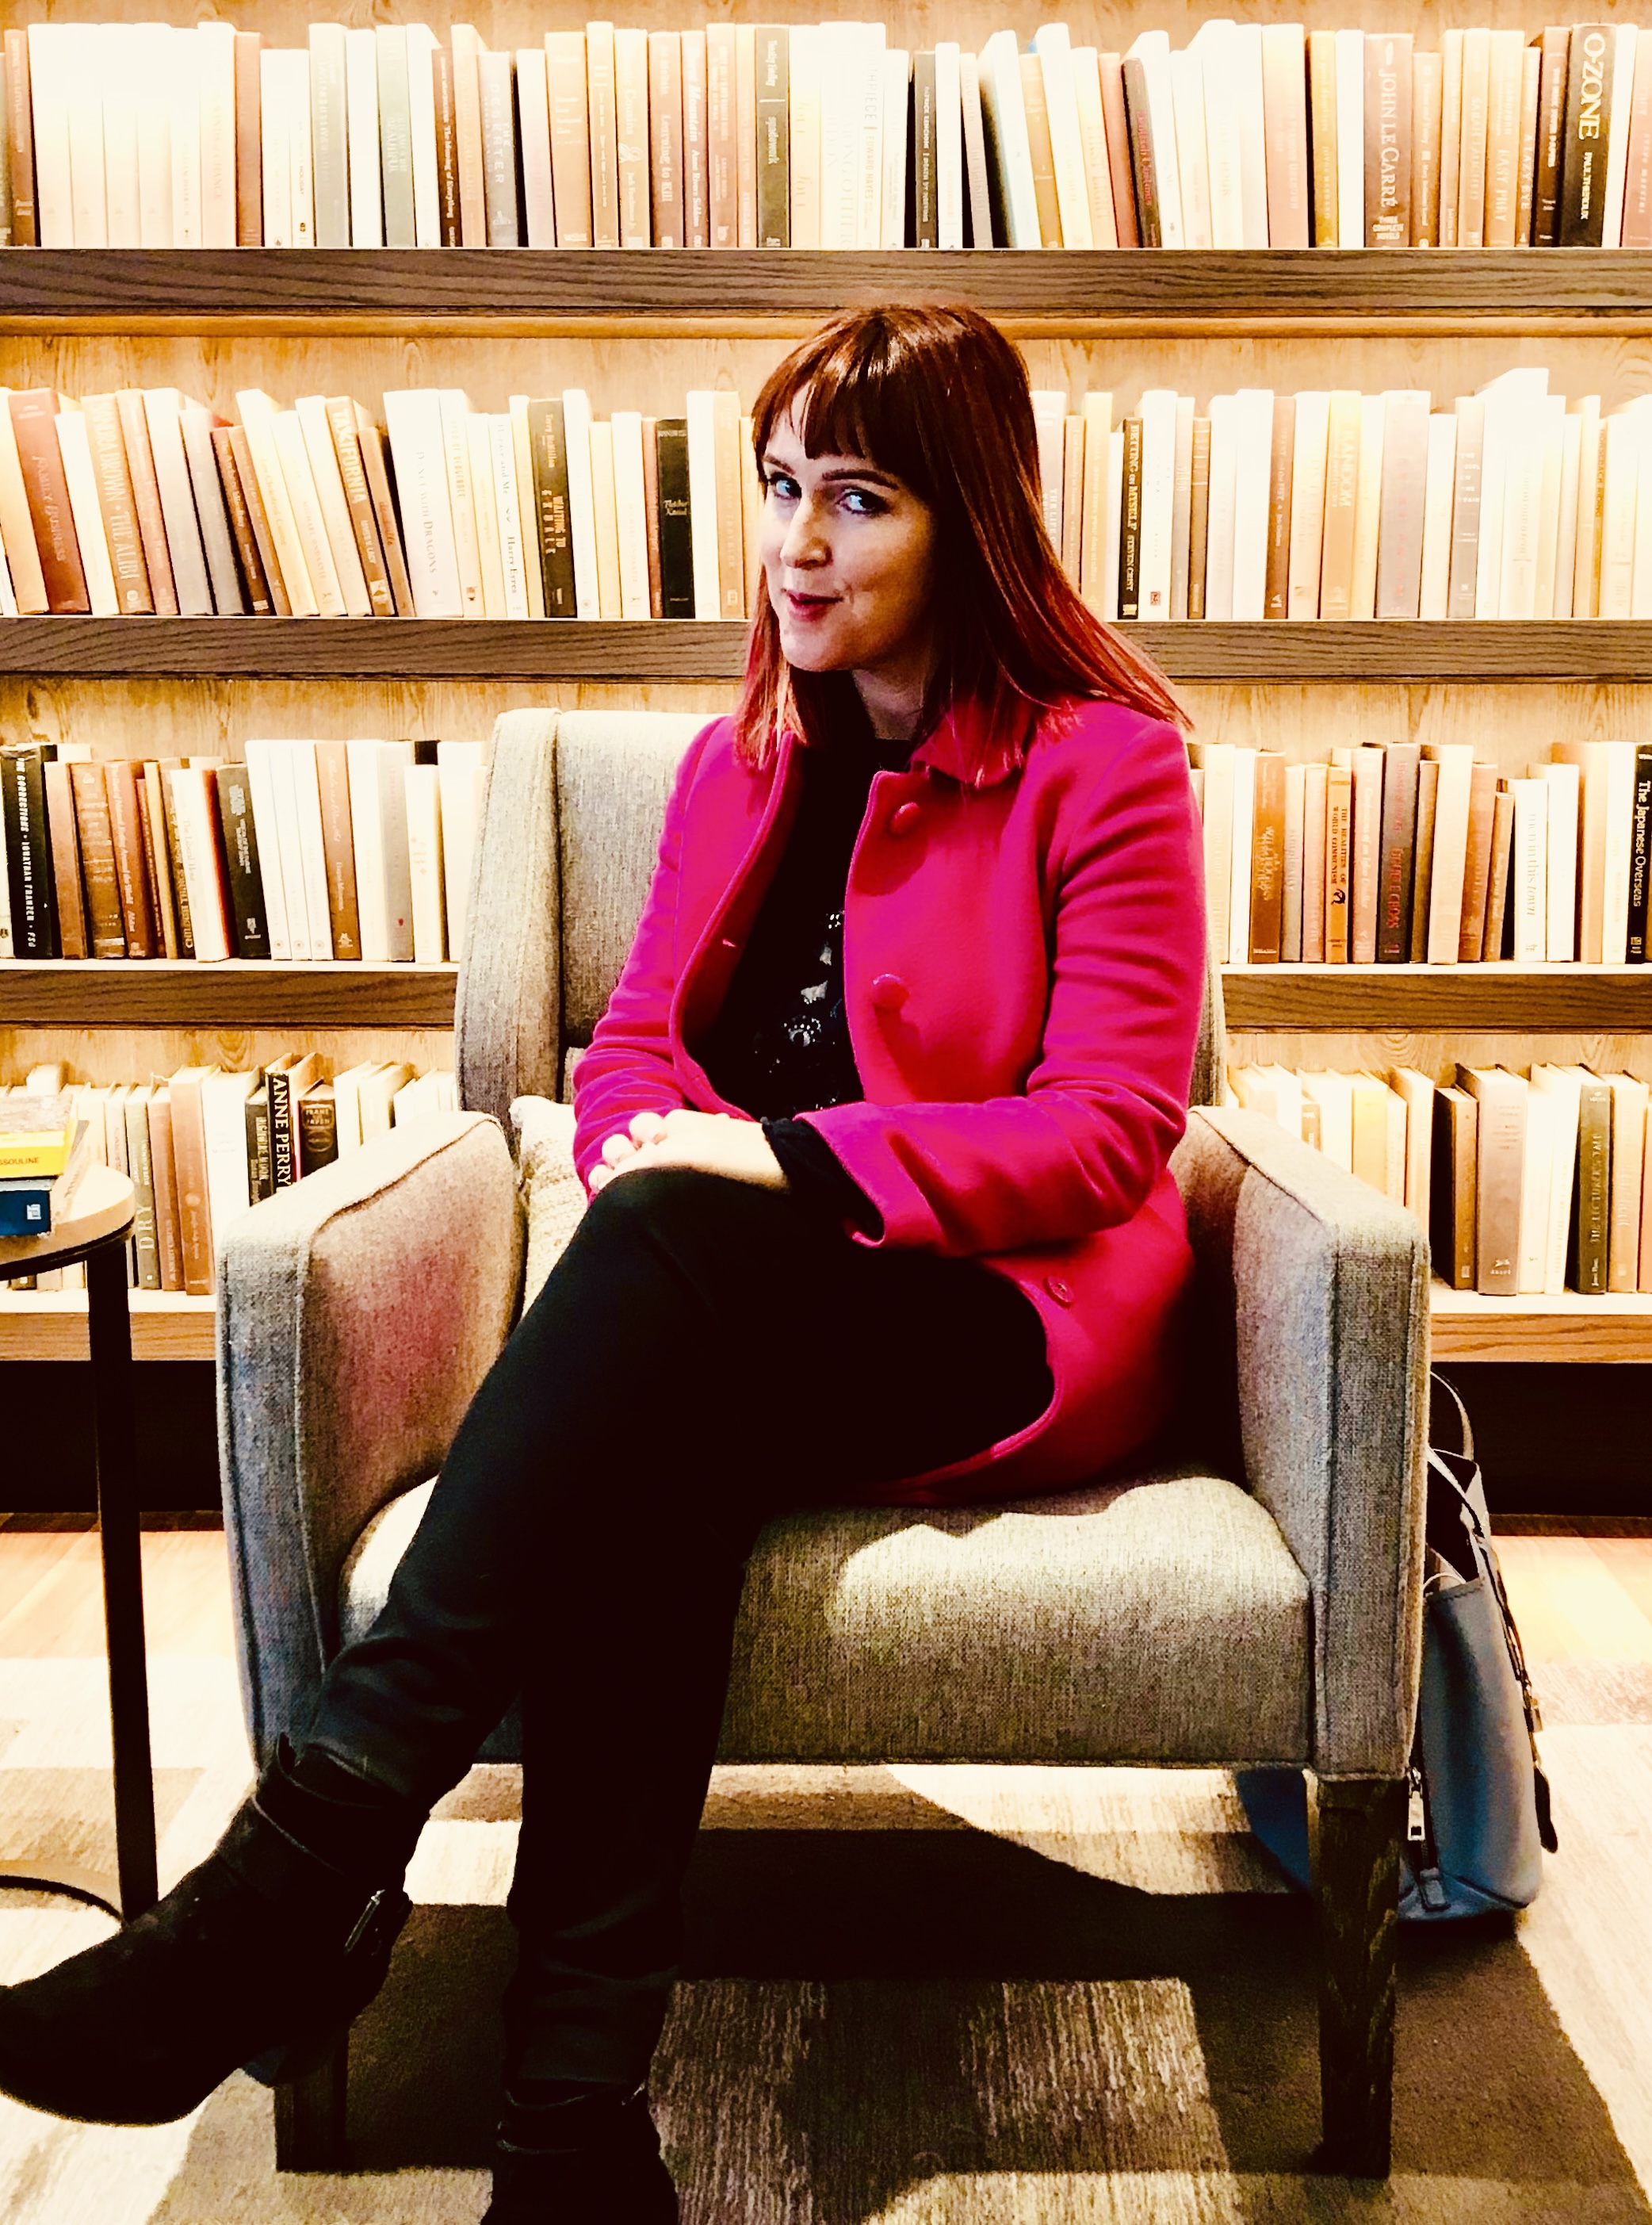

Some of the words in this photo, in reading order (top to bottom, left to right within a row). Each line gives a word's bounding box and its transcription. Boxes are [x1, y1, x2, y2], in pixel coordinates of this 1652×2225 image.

[1378, 68, 1398, 118] JOHN
[1578, 33, 1606, 141] O-ZONE
[212, 105, 221, 142] WINDS
[623, 89, 637, 135] Cousins
[687, 84, 702, 142] Mountain
[490, 82, 504, 183] DESERTER
[660, 114, 672, 164] Learning
[767, 116, 779, 164] spadework
[1087, 125, 1106, 170] FIRST
[1380, 123, 1397, 144] LE
[691, 149, 700, 170] Anne
[864, 136, 874, 170] EDWARD
[1521, 147, 1533, 182] LAZY
[1583, 152, 1593, 172] PAUL
[213, 154, 223, 201] CHANGE
[662, 167, 672, 178] to
[692, 172, 701, 196] Rivers
[864, 174, 874, 199] HAYES
[1221, 161, 1232, 197] FOUR
[1380, 147, 1400, 208] CARRÉ
[444, 181, 456, 218] Everything
[661, 182, 673, 202] Kill
[1091, 175, 1111, 221] LIGHT
[1580, 172, 1592, 220] THEROUX
[692, 197, 702, 227] Siddons
[91, 401, 118, 452] SANDRA
[544, 414, 554, 433] Terry
[546, 435, 556, 469] McMillan
[1128, 424, 1140, 473] BETTING
[1596, 428, 1606, 484] HORSEBACK
[98, 451, 123, 502] BROWN
[331, 408, 367, 504] TAXIFORNIA
[365, 547, 377, 564] LACY
[453, 456, 466, 498] VENGEANCE
[499, 461, 508, 478] and
[1338, 431, 1355, 507] RANDOM
[419, 492, 430, 517] WITH
[502, 481, 510, 495] Me
[1049, 488, 1057, 508] THE
[1594, 486, 1603, 518] RIDING
[33, 456, 53, 500] FAMILY
[44, 505, 66, 561] BUSINESS
[553, 496, 565, 534] WAITING
[1050, 511, 1058, 534] LIFE
[1090, 515, 1099, 534] your
[1126, 486, 1138, 530] MYSELF
[109, 512, 129, 541] THE
[556, 537, 567, 548] TO
[116, 541, 139, 580] ALIBI
[423, 521, 437, 574] DRAGONS
[506, 536, 517, 565] Harry
[1126, 567, 1134, 592] CRIST
[15, 758, 27, 772] THE
[16, 775, 29, 832] CORRECTIONS
[237, 787, 246, 814] STAR
[1639, 780, 1651, 802] The
[182, 819, 191, 833] The
[1263, 825, 1275, 855] WILL
[1361, 835, 1373, 844] of
[1527, 814, 1538, 843] men
[1635, 803, 1650, 854] Japanese
[21, 841, 34, 882] JONATHAN
[120, 848, 131, 872] Around
[184, 837, 194, 860] Liberal
[1527, 844, 1539, 857] in
[1340, 873, 1347, 885] OF
[1526, 859, 1540, 883] this
[1633, 856, 1646, 907] Overseas
[24, 884, 36, 921] FRANZEN
[124, 883, 134, 904] World
[1526, 886, 1539, 915] town
[1386, 893, 1401, 929] CROSS
[27, 932, 36, 948] FSG
[272, 1078, 290, 1129] ANNE
[250, 1158, 259, 1179] Susan
[258, 1156, 270, 1181] MOON
[275, 1133, 292, 1185] PERRY
[136, 1202, 155, 1250] DRY
